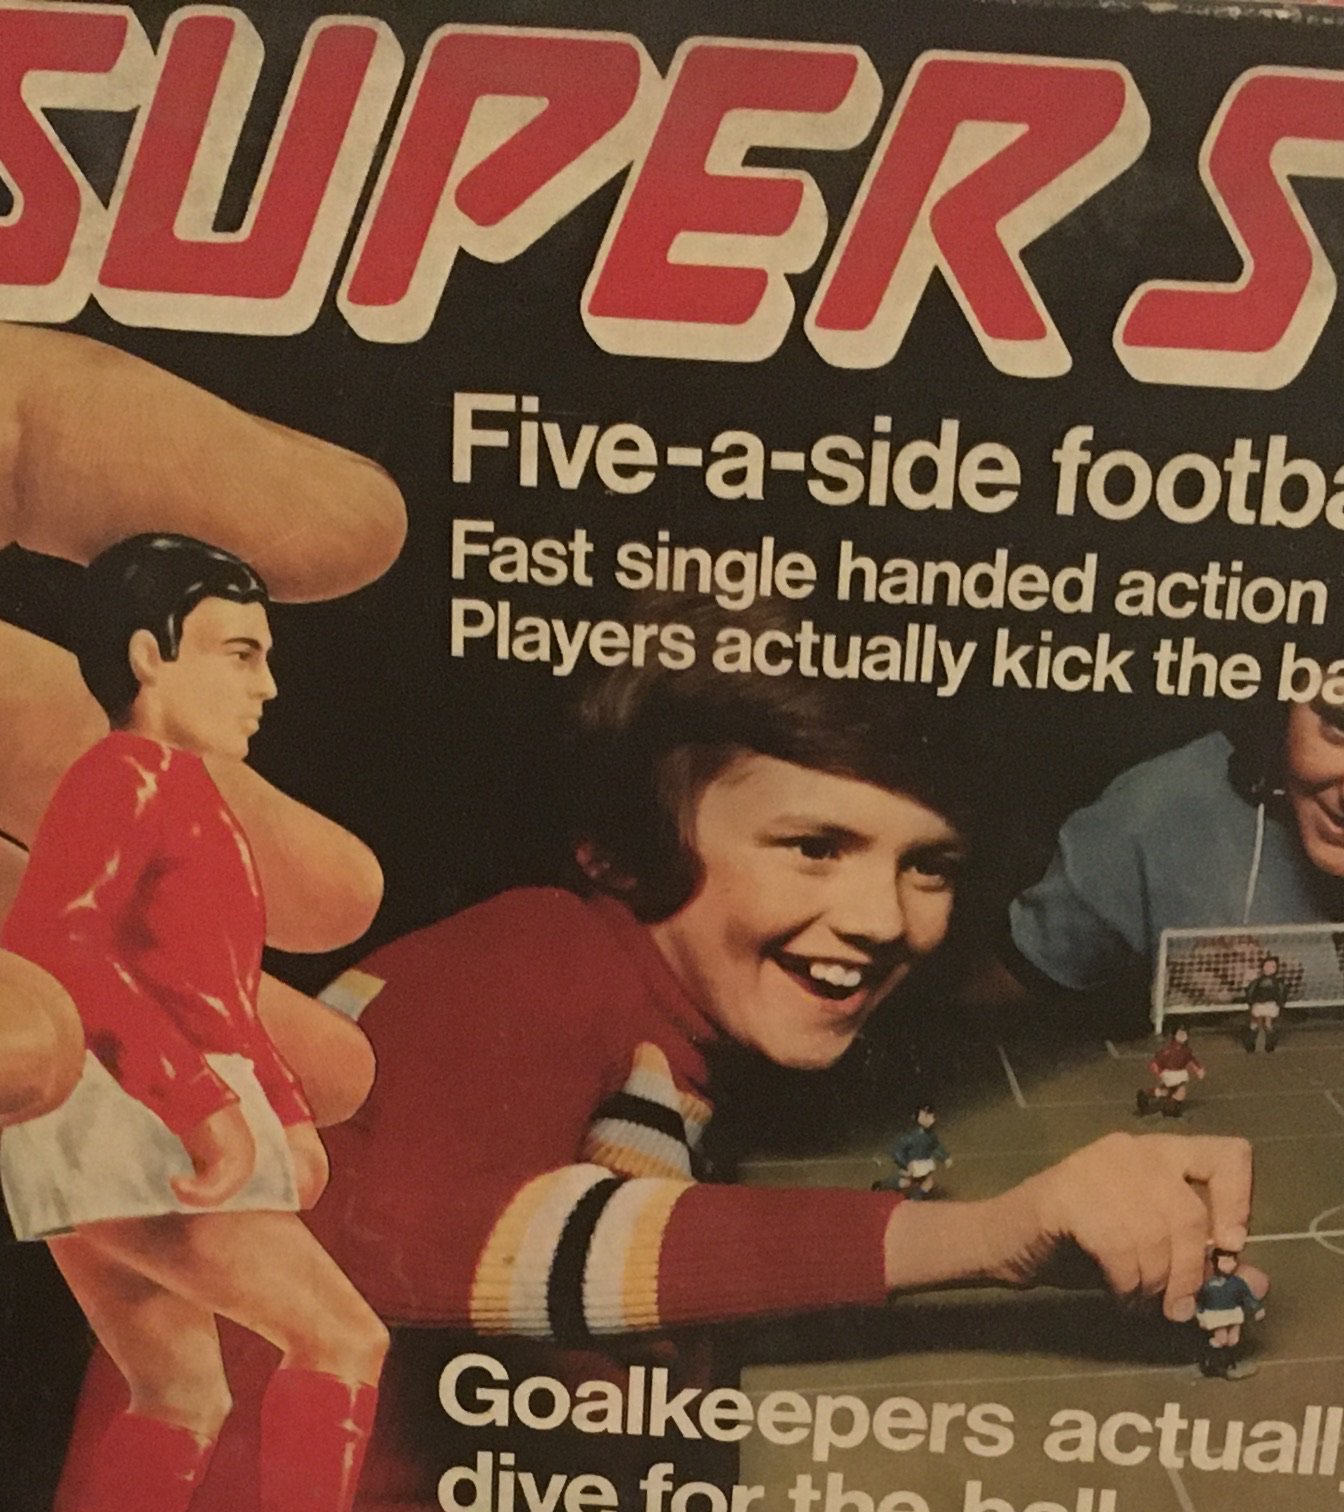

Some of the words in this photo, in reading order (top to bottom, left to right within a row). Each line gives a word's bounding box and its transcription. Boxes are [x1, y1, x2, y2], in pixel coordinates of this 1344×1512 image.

[451, 390, 1024, 514] Five-a-side
[451, 518, 595, 590] Fast
[614, 529, 818, 611] single
[837, 540, 1101, 614] handed
[1114, 557, 1329, 627] action
[451, 597, 698, 677] Players
[711, 618, 978, 698] actually
[991, 628, 1135, 695] kick
[1152, 637, 1263, 702] the
[437, 1351, 1016, 1461] Goalkeepers
